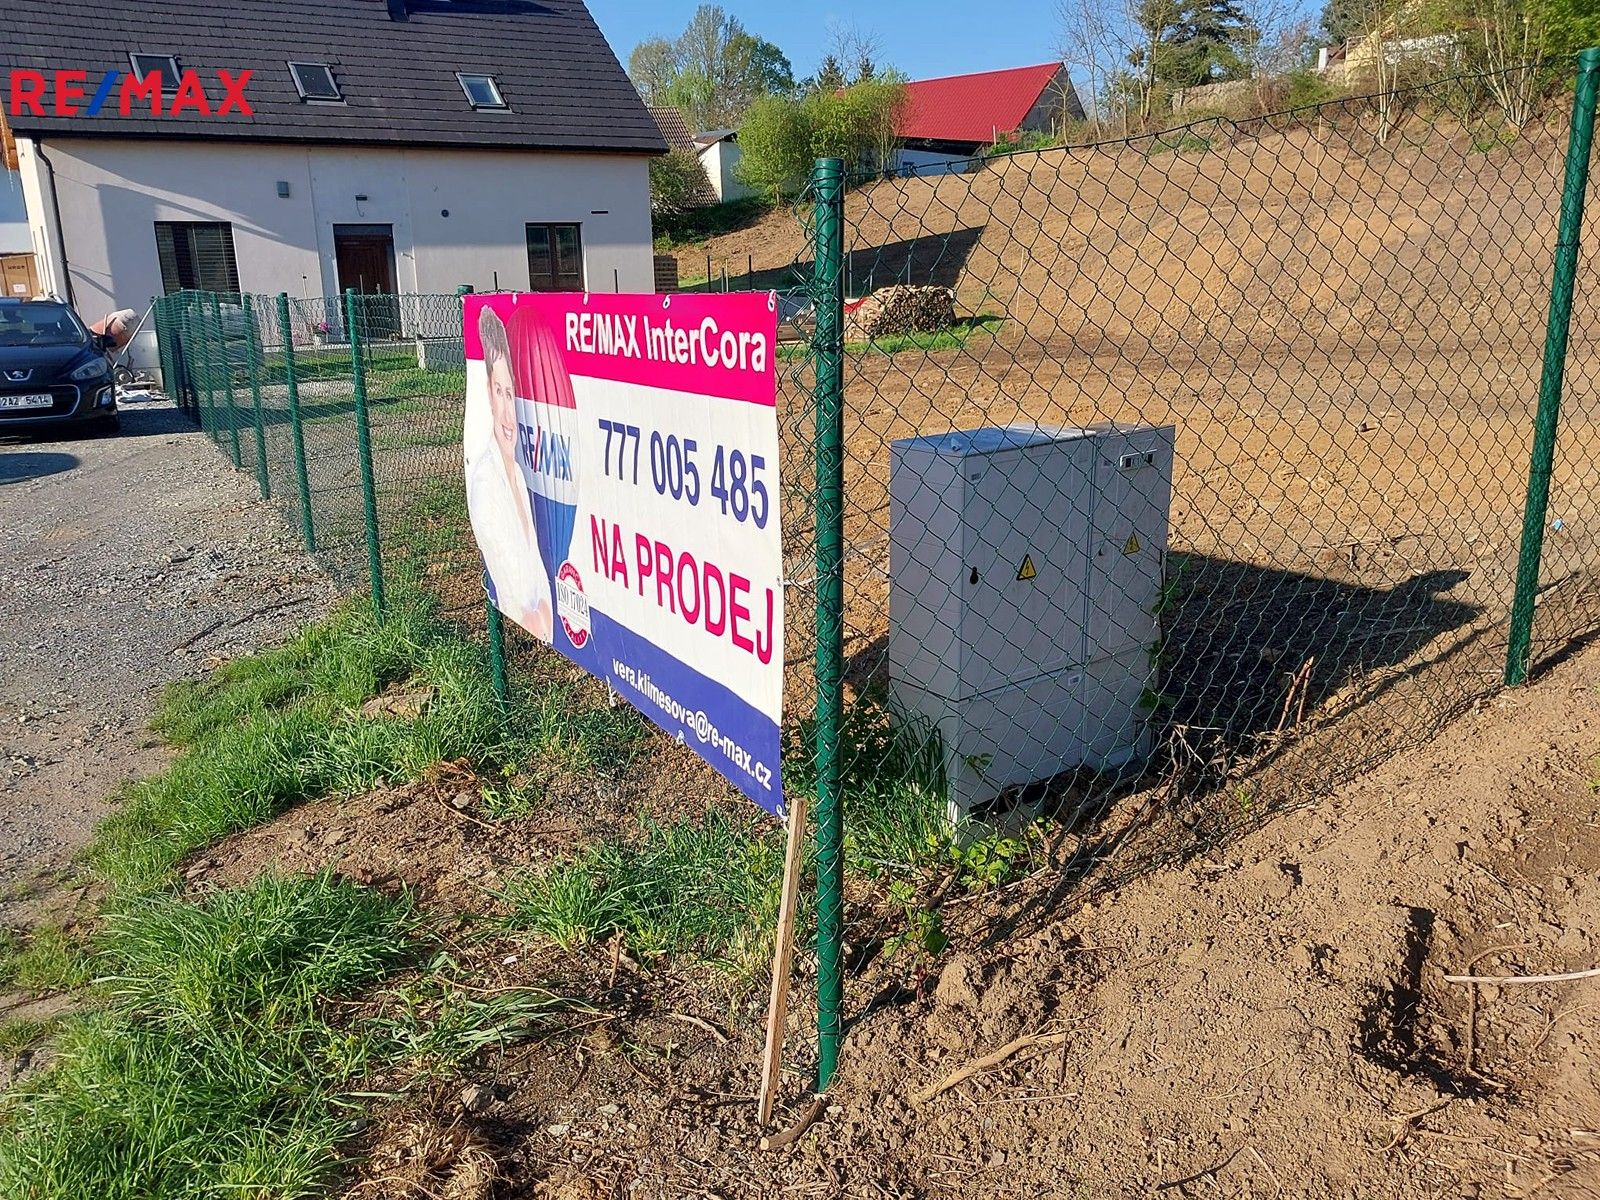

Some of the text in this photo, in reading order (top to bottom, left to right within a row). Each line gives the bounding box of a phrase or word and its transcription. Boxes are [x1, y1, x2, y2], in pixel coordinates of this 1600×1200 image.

[565, 312, 767, 373] RE/MAX InterCora
[518, 422, 573, 482] RE/MAX
[598, 418, 769, 530] 777 005 485
[590, 513, 774, 665] NA PRODEJ
[612, 657, 772, 791] vera.klimesova@re-max.cz
